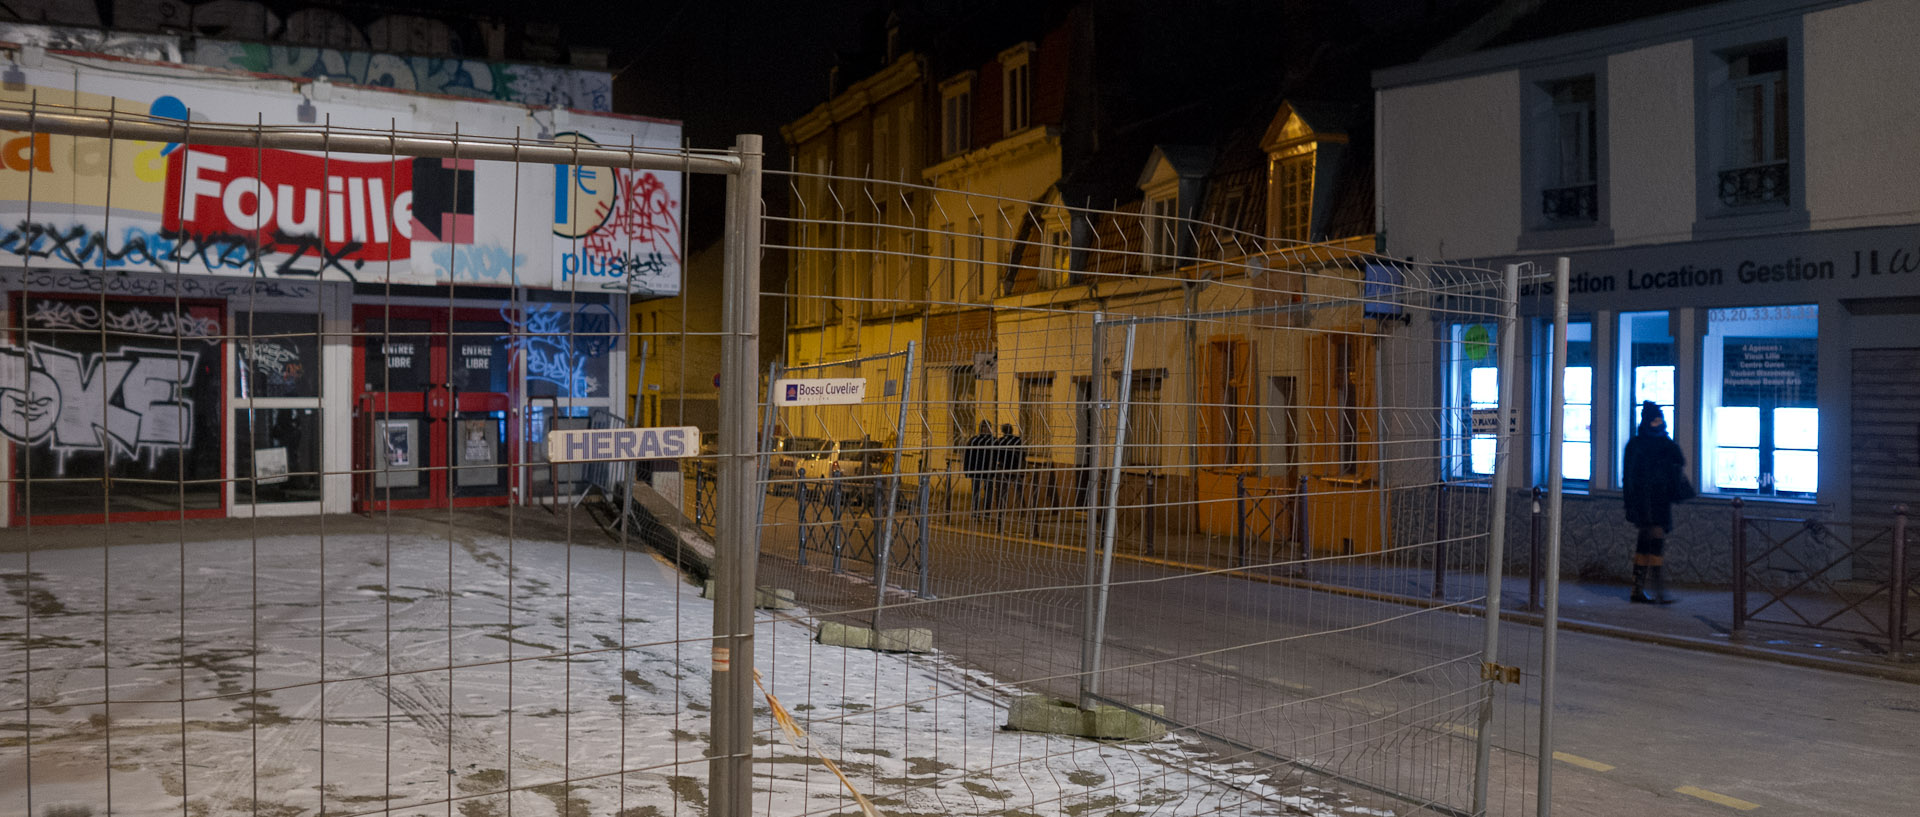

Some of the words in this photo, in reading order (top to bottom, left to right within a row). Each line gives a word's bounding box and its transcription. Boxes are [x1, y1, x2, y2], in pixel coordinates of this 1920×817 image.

[562, 246, 624, 282] plus
[1628, 267, 1723, 290] Location
[1738, 257, 1835, 284] Gestion
[466, 358, 489, 369] LIBRE
[800, 384, 824, 395] Bossu
[826, 383, 859, 395] Cuvelier
[566, 429, 685, 460] HERAS
